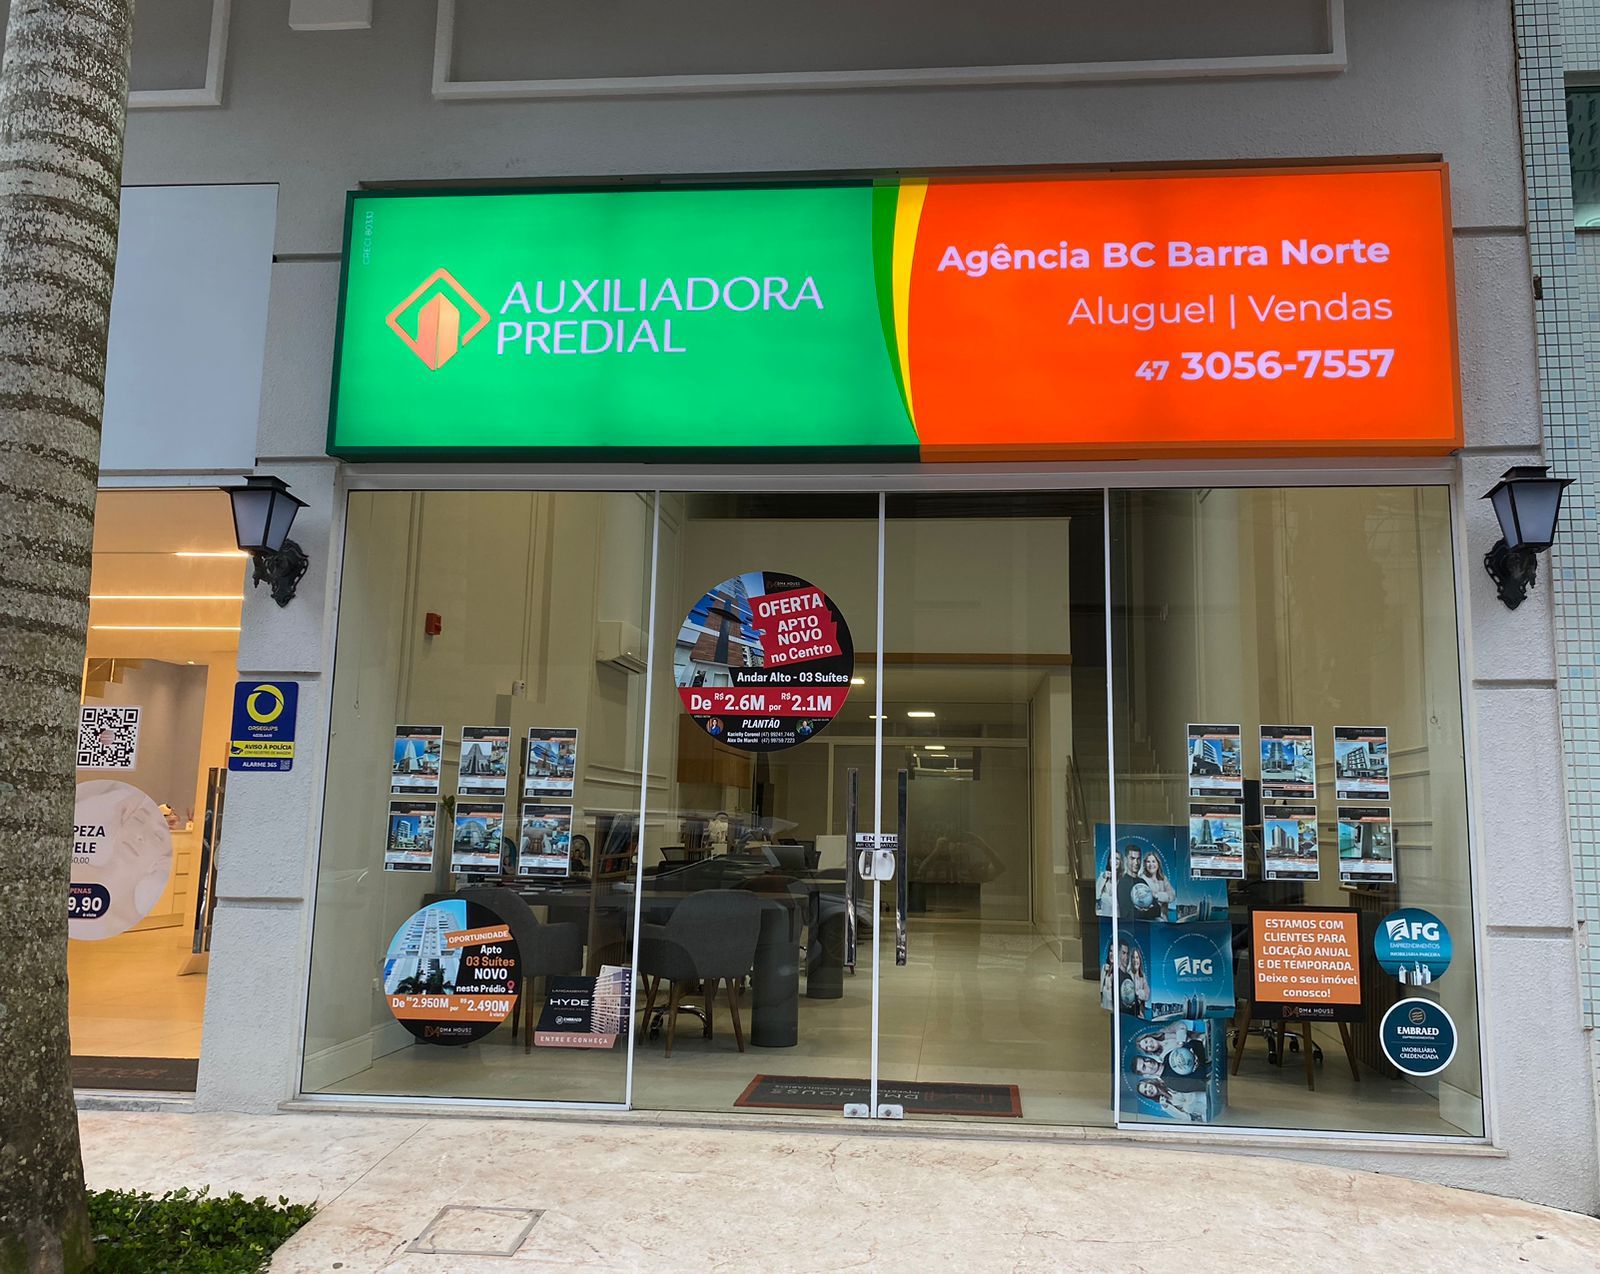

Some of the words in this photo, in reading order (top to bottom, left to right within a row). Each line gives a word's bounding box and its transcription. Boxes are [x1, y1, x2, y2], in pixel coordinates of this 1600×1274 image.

[937, 240, 1090, 277] Agência
[1103, 242, 1156, 269] BC
[1168, 240, 1268, 267] Barra
[1282, 238, 1390, 265] Norte
[499, 274, 825, 315] AUXILIADORA
[1067, 294, 1215, 331] Aluguel
[1247, 292, 1393, 322] Vendas
[496, 318, 687, 355] PREDIAL
[1134, 360, 1170, 381] 47
[1181, 348, 1394, 380] 3056-7557
[758, 593, 824, 618] OFERTA
[777, 615, 819, 632] APTO
[777, 628, 823, 646] NOVO
[771, 651, 787, 664] no
[788, 644, 833, 661] Centro
[736, 672, 768, 683] Andar
[769, 672, 791, 683] Alto
[799, 673, 813, 683] 03
[814, 671, 849, 683] Suítes
[690, 694, 712, 711] De
[714, 692, 725, 701] R$
[724, 694, 765, 711] 2.6M
[768, 703, 782, 712] por
[781, 692, 791, 701] R$
[791, 695, 832, 711] 2.1M
[742, 717, 781, 729] PLANTÃO
[73, 842, 97, 854] ELE
[1265, 918, 1317, 929] ESTAMOS
[1319, 919, 1344, 930] COM
[448, 930, 509, 944] OPORTUNIDADE
[1263, 932, 1315, 943] CLIENTES
[1317, 933, 1347, 944] PARA
[1411, 922, 1440, 941] FG
[480, 944, 503, 956] Apto
[1262, 944, 1312, 958] LOCAÇÃO
[1314, 947, 1351, 957] ANUAL
[465, 956, 480, 967] 03
[481, 955, 516, 967] Suítes
[1192, 958, 1213, 975] FG
[1257, 959, 1265, 969] E
[1267, 959, 1281, 969] DE
[1283, 960, 1355, 971] TEMPORADA.
[474, 968, 508, 980] NOVO
[1258, 972, 1289, 983] Deixe
[1300, 976, 1319, 984] seu
[1321, 974, 1358, 985] imóvel
[456, 985, 479, 994] neste
[480, 983, 506, 994] Prédio
[1283, 988, 1331, 998] conosco!
[392, 997, 406, 1008] De
[412, 998, 449, 1008] 2.950M
[467, 1000, 510, 1012] 2.490M
[550, 998, 590, 1006] HYDE
[1397, 1026, 1440, 1036] EMBRAED
[540, 1035, 564, 1043] ENTRE
[572, 1036, 608, 1045] CONHEÇA
[1399, 1052, 1439, 1060] CREDENCIADA
